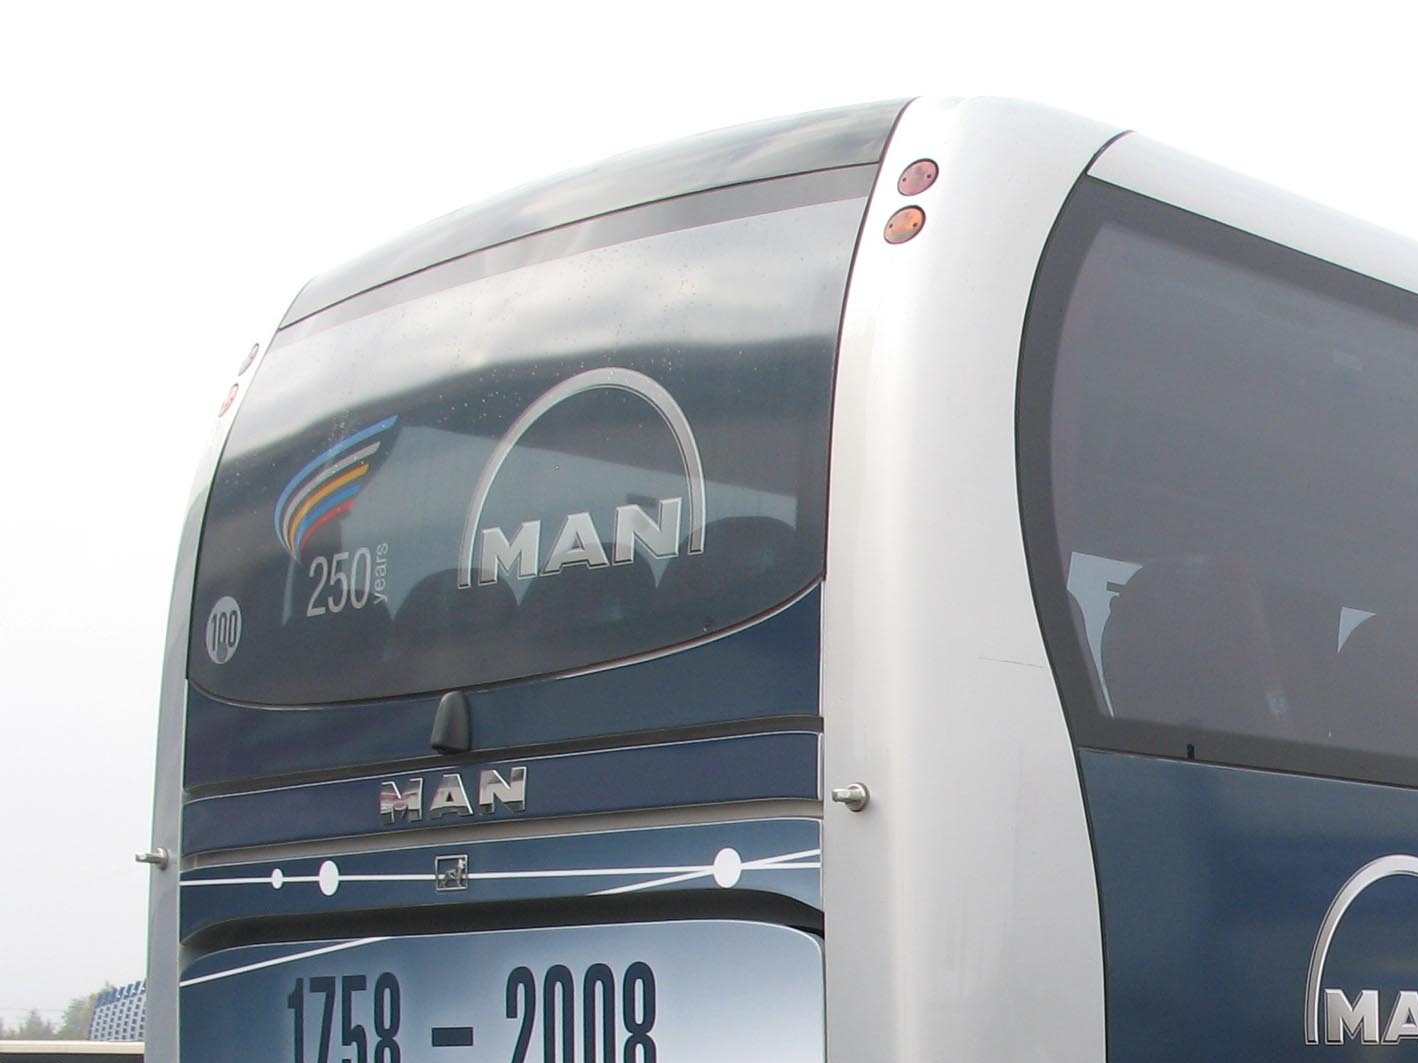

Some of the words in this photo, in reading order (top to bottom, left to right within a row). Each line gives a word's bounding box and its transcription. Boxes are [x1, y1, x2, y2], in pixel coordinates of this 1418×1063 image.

[477, 496, 682, 587] MAN
[305, 546, 373, 618] 250
[373, 542, 389, 605] years
[209, 609, 239, 652] 100
[379, 765, 528, 824] MAN
